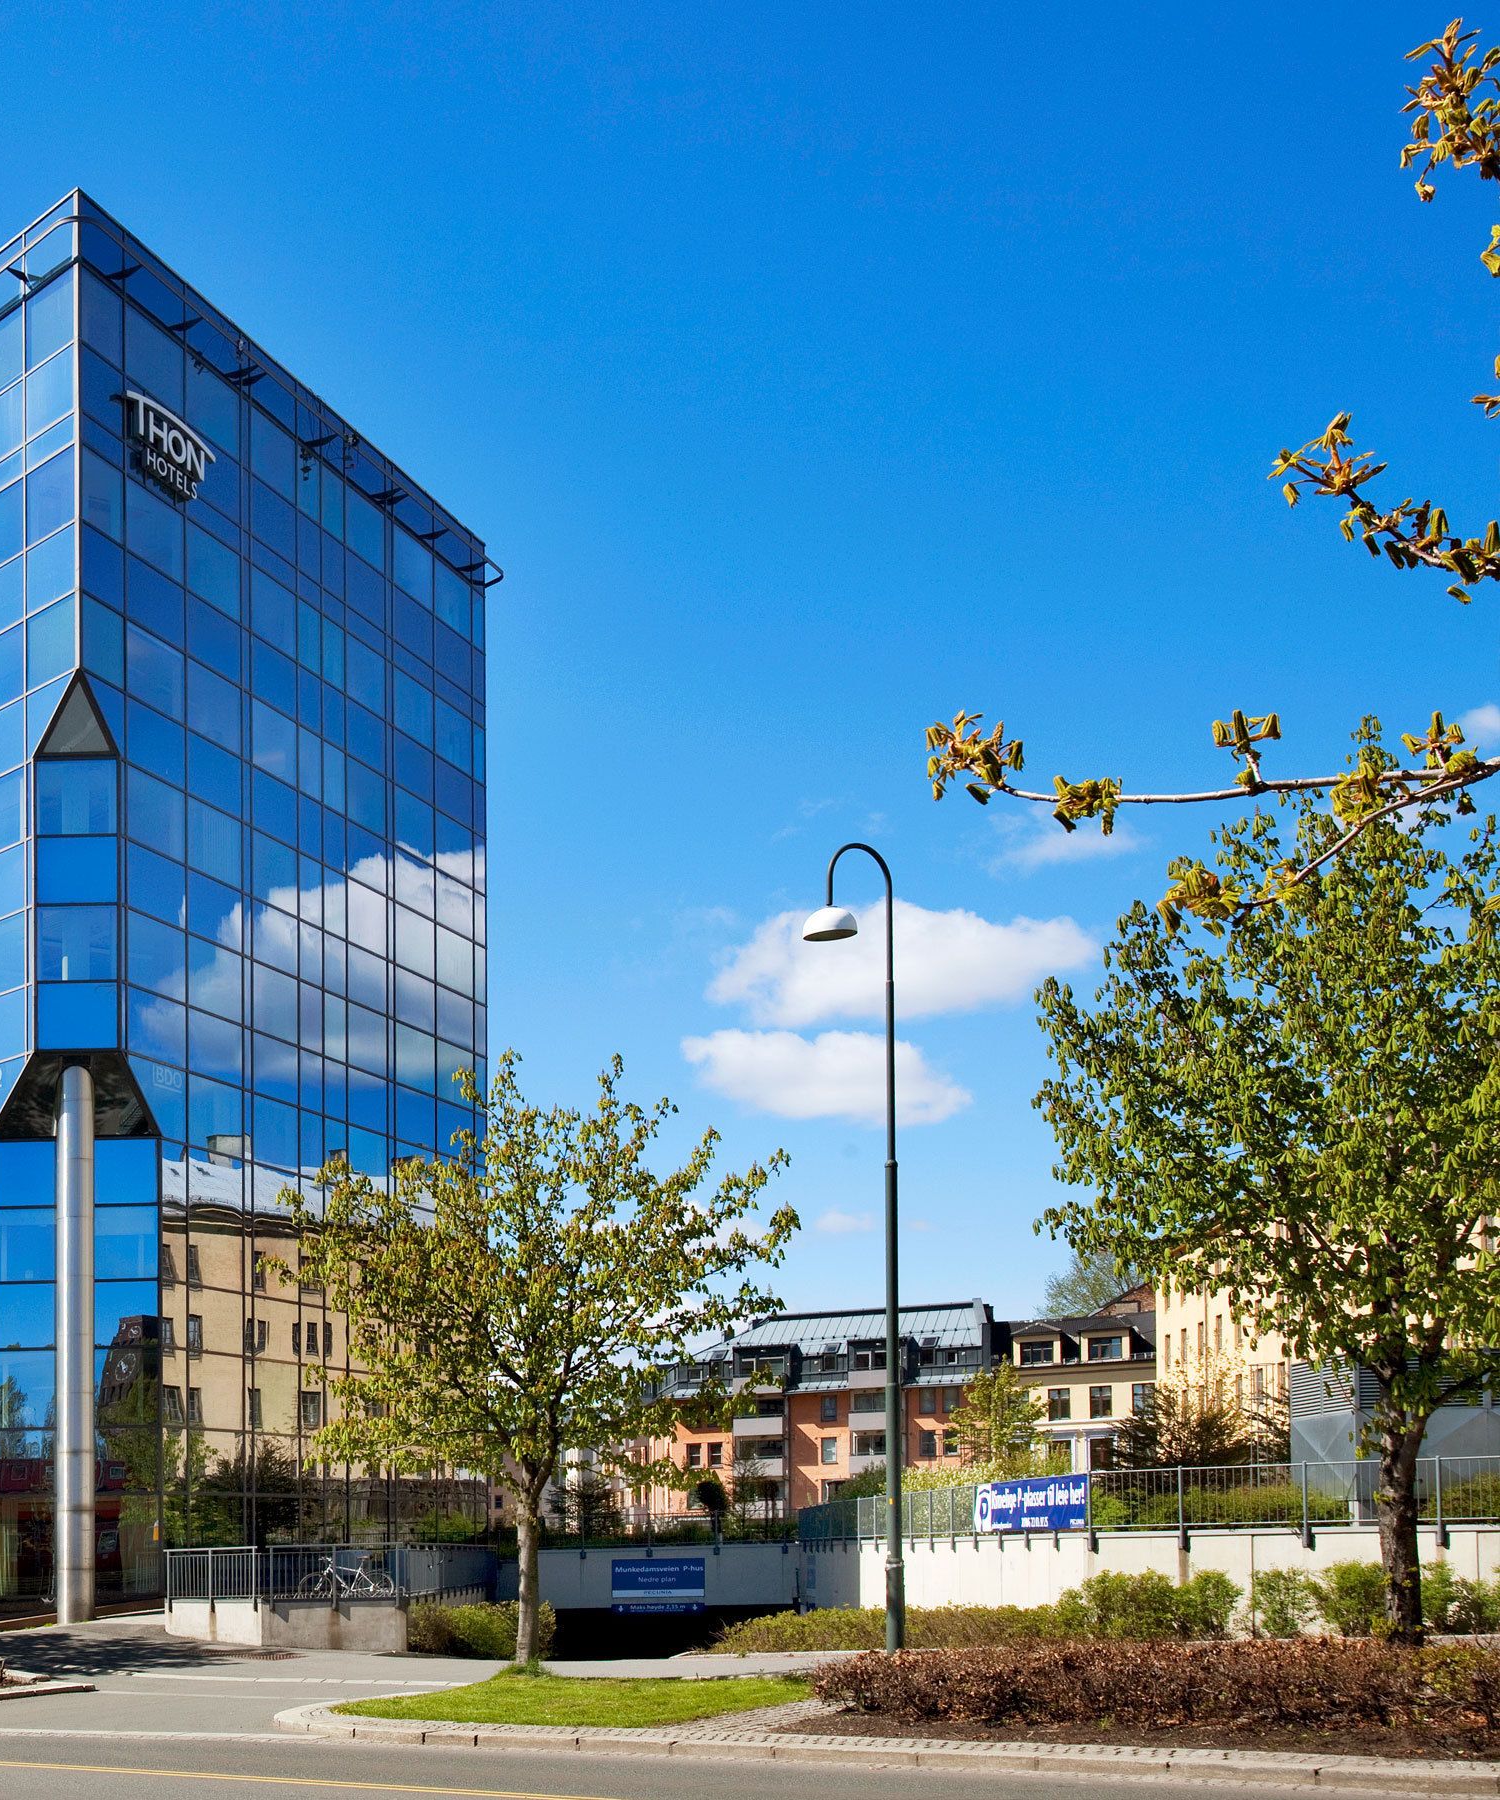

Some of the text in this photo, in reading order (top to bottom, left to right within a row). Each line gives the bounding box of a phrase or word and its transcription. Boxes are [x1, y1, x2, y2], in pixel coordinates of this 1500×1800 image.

[126, 390, 216, 481] THON
[146, 448, 197, 500] HOTELS
[156, 1065, 182, 1089] BDO
